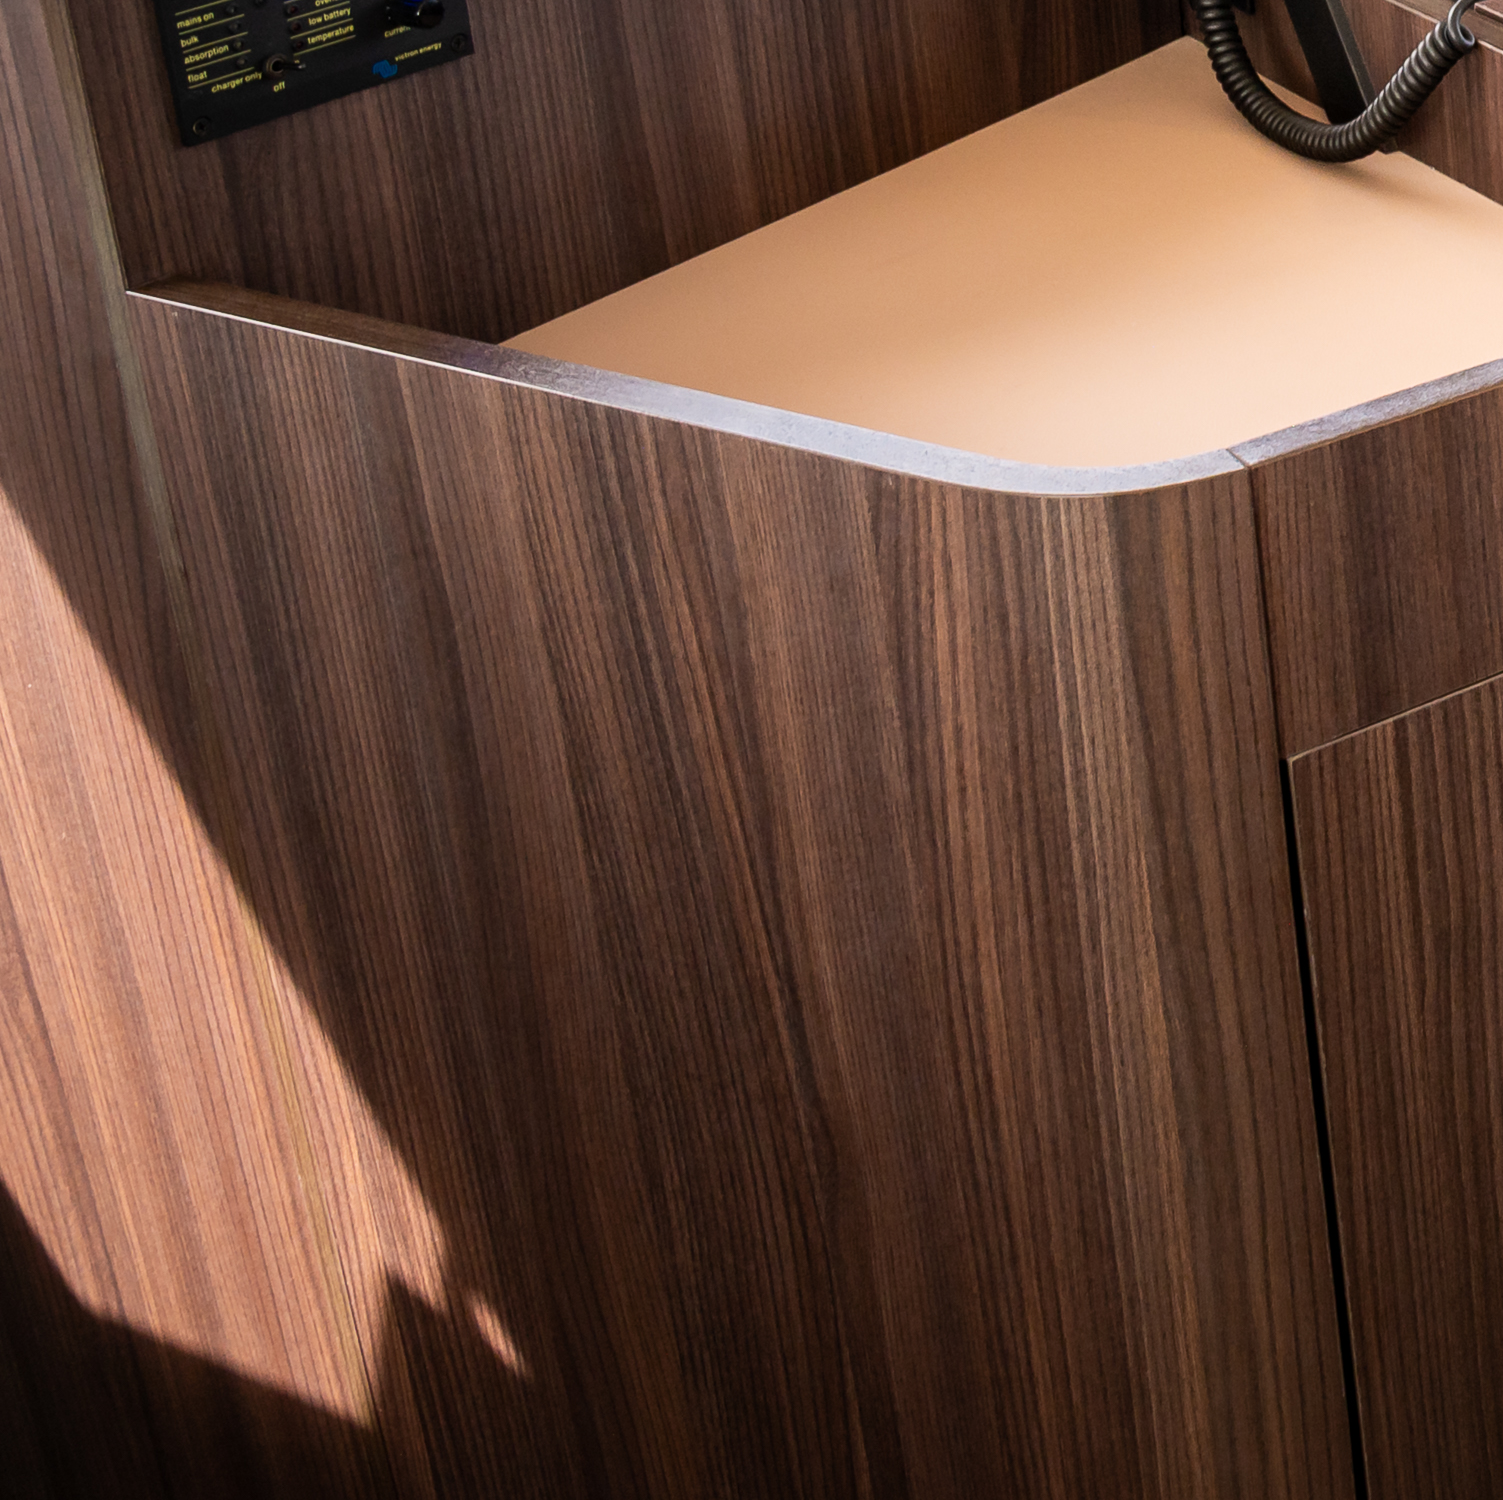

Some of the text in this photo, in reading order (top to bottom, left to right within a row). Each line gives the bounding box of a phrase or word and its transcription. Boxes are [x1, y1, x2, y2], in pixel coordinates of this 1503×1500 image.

[176, 12, 215, 29] mains on
[308, 7, 351, 26] low battery
[180, 35, 199, 48] bulk
[307, 24, 355, 45] temperature
[184, 43, 229, 64] absorption
[394, 41, 443, 62] victron energy
[187, 70, 208, 83] float
[211, 70, 263, 93] charger only
[273, 80, 286, 92] off
